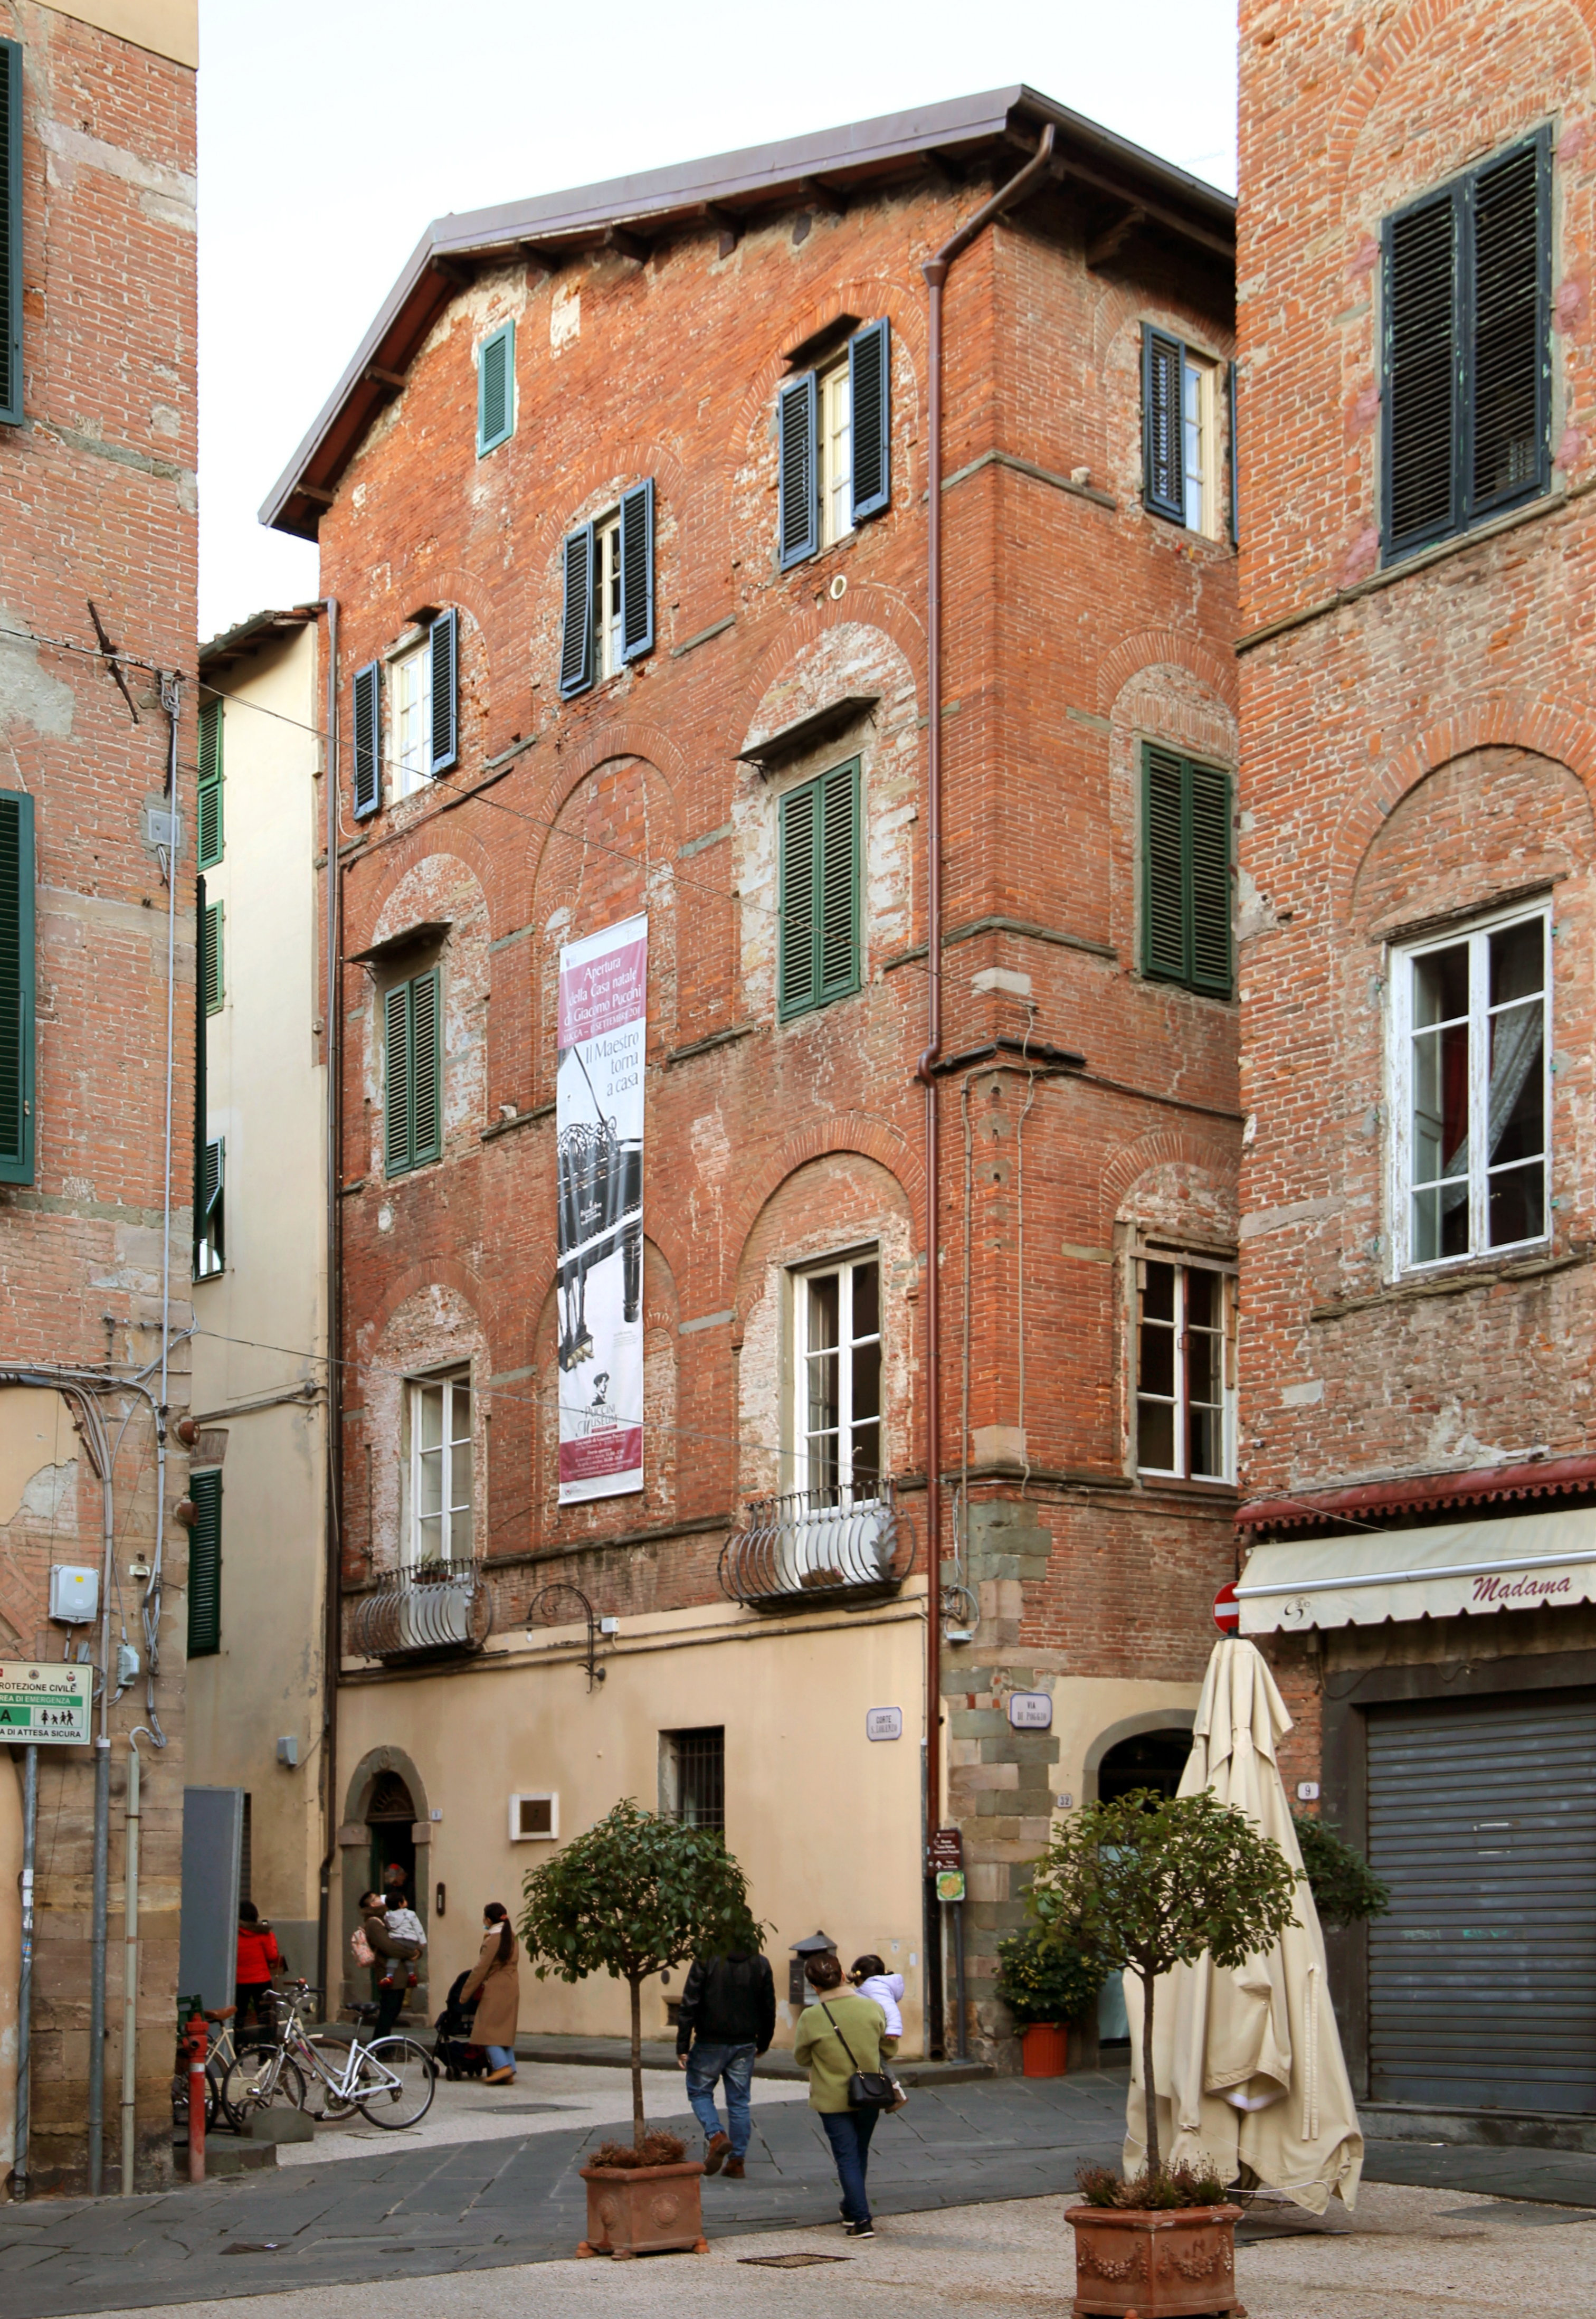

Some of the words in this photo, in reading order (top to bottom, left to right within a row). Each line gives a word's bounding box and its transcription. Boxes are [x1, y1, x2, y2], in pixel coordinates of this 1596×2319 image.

[584, 958, 621, 983] Apertura
[568, 988, 588, 1006] della
[590, 978, 610, 997] Casa
[612, 967, 637, 989] natale
[573, 1000, 610, 1022] Giacomo
[612, 984, 641, 1008] Puccini
[563, 1028, 583, 1043] LUCCA
[595, 1011, 628, 1031] SETTEMBRE
[586, 1045, 593, 1064] Il
[594, 1031, 639, 1061] Maestro
[611, 1052, 639, 1075] torna
[606, 1082, 613, 1097] a
[615, 1072, 639, 1093] casa
[585, 1404, 615, 1418] PUCCINI
[576, 1413, 618, 1438] MUSEUM
[1473, 1575, 1572, 1602] Madama
[0, 1682, 47, 1691] ROTEZIONE
[0, 1709, 12, 1722] A
[1018, 1711, 1023, 1721] DI
[1027, 1711, 1047, 1721] POGGIO
[1027, 1701, 1036, 1709] VIA
[876, 1715, 892, 1724] CORTE
[1060, 1796, 1069, 1805] 32
[1305, 1784, 1311, 1797] 9
